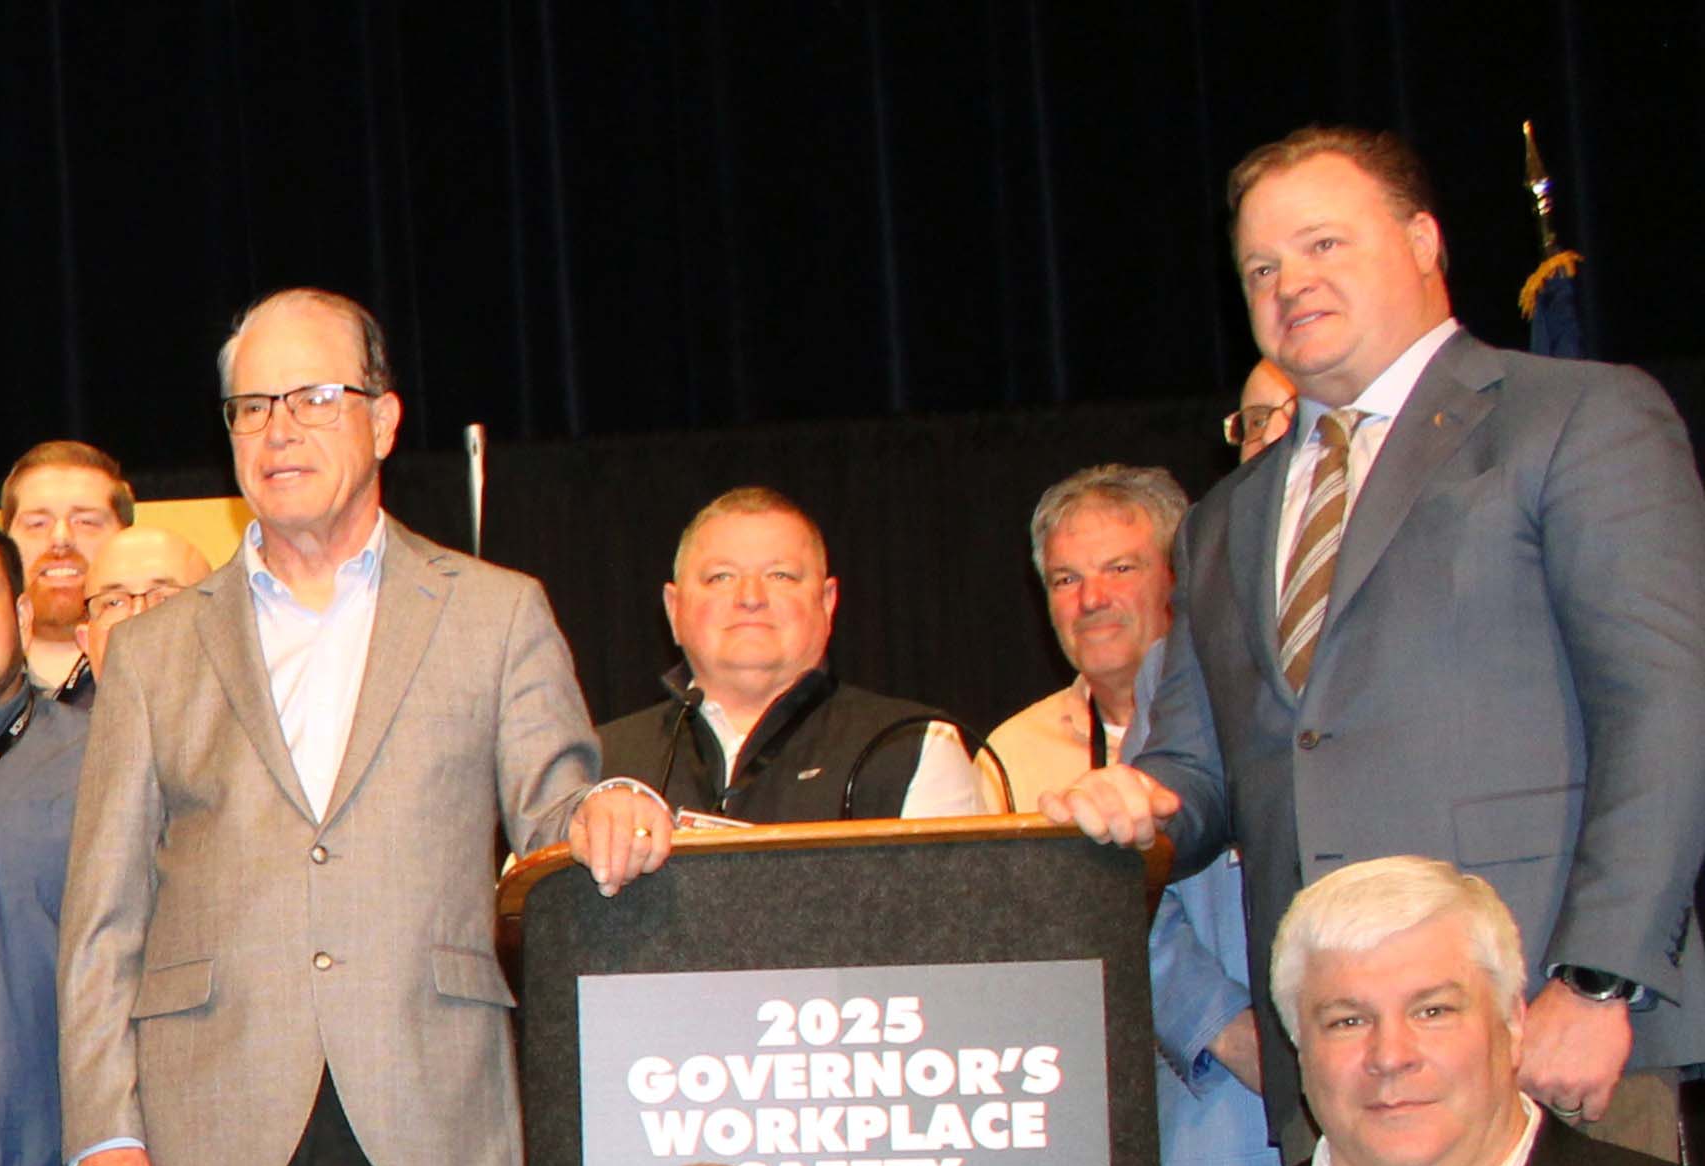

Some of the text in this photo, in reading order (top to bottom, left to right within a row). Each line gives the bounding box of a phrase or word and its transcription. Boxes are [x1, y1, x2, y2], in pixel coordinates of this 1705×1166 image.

[757, 996, 923, 1047] 2025
[627, 1047, 1061, 1104] GOVERNOR'S
[640, 1101, 1047, 1157] WORKPLACE
